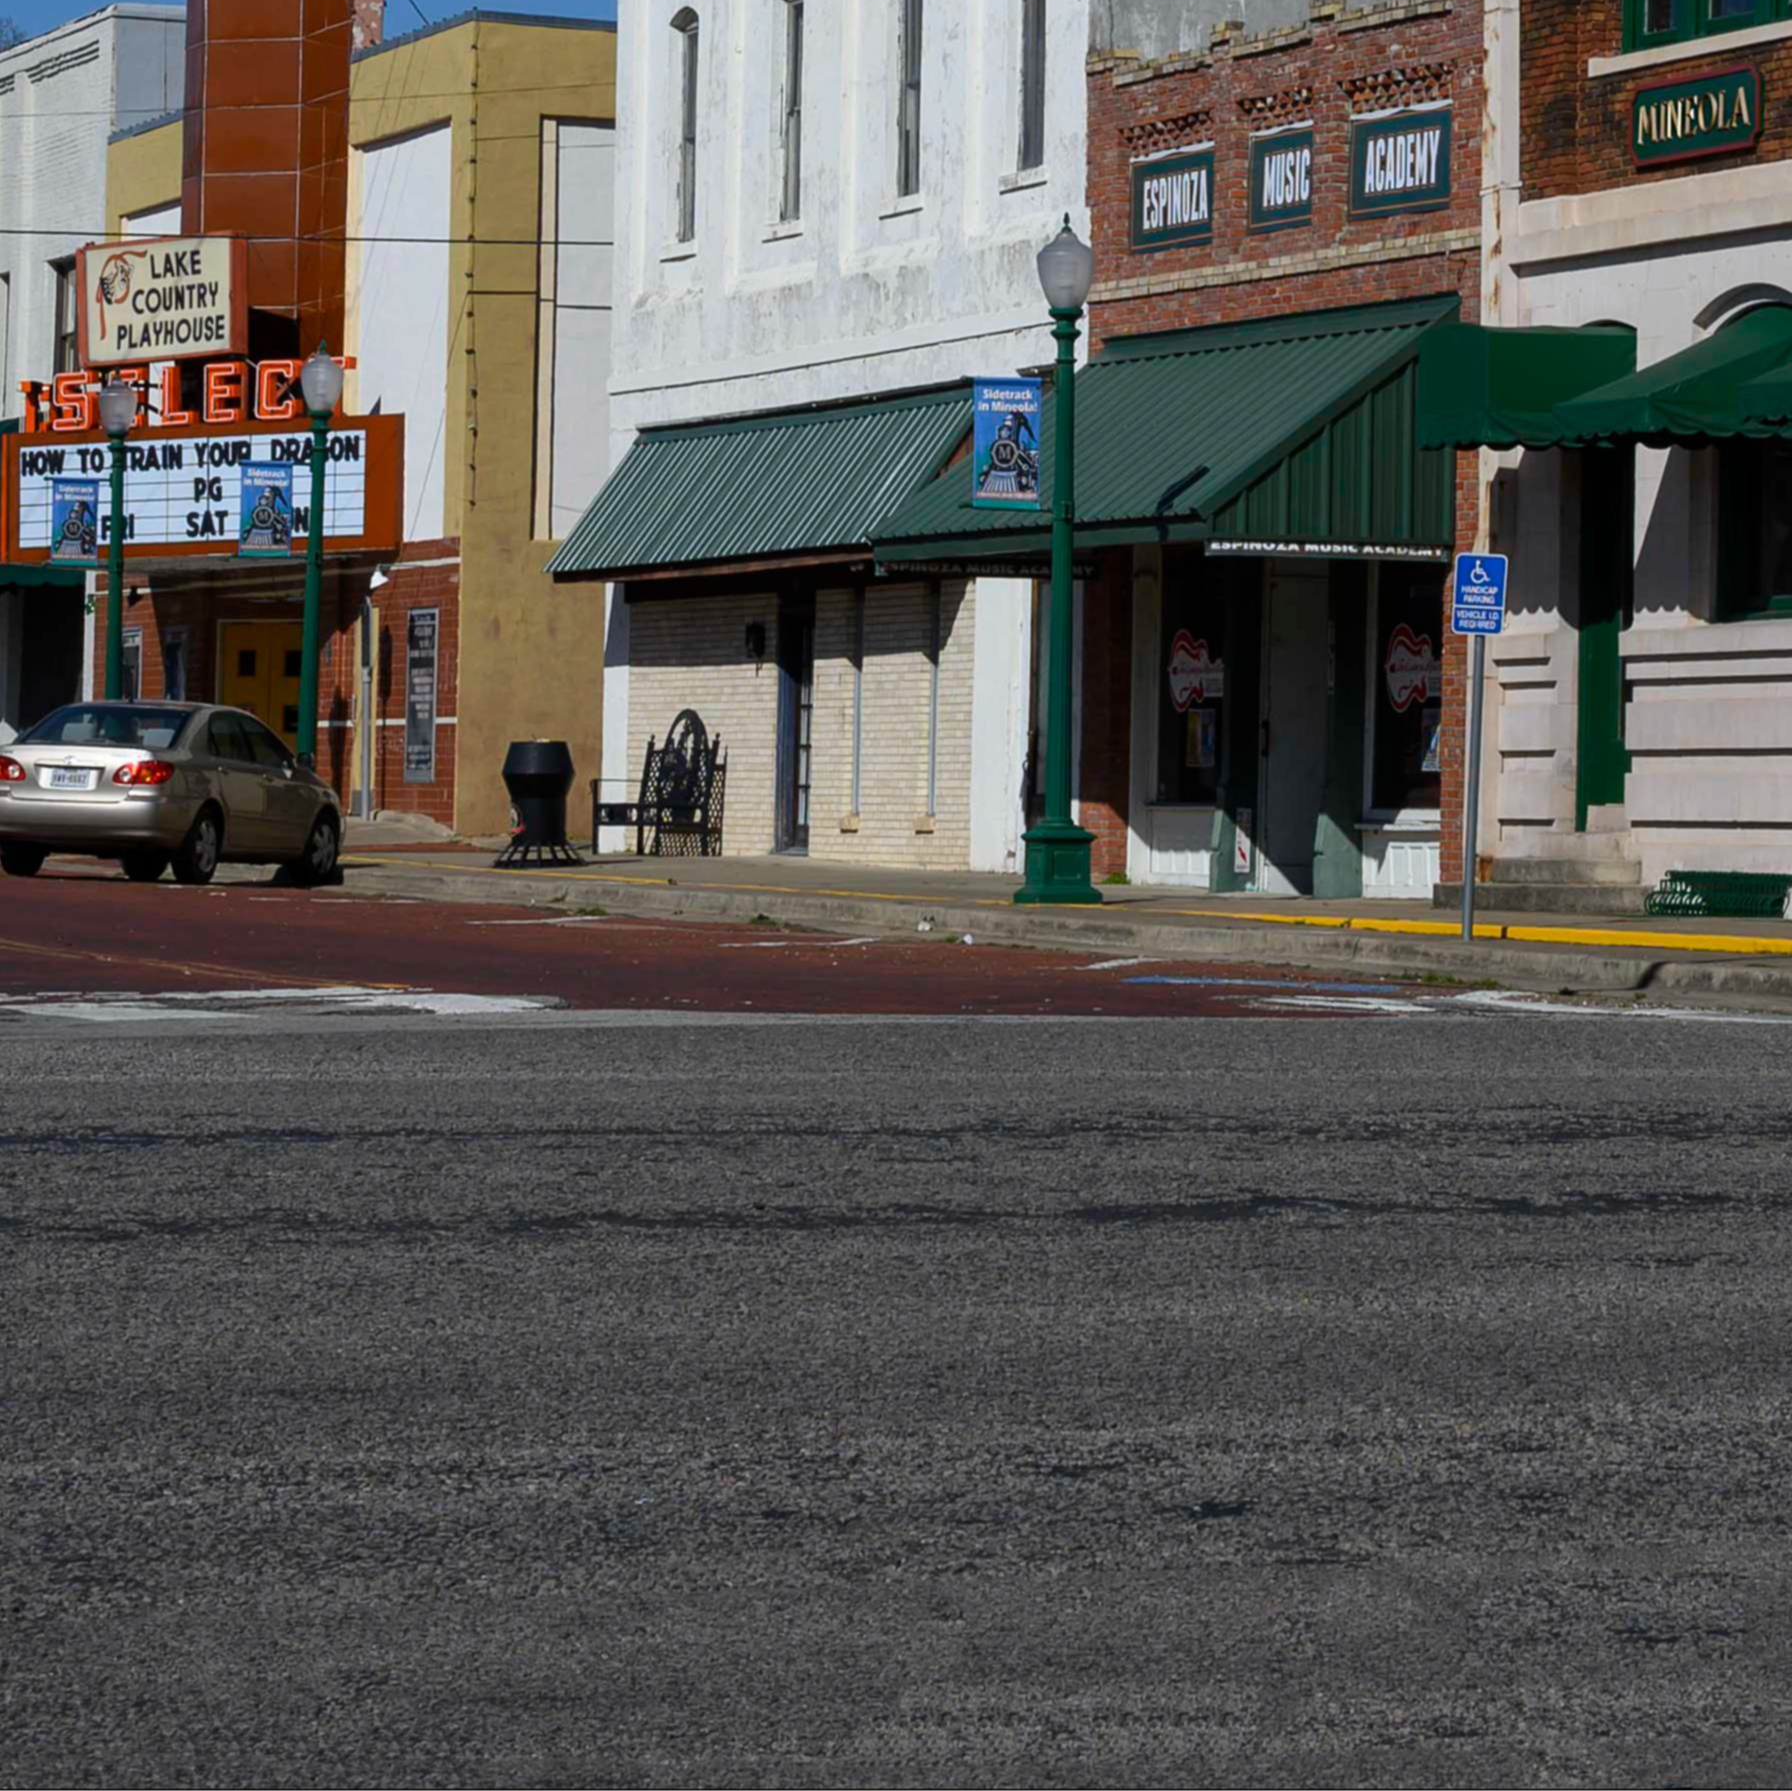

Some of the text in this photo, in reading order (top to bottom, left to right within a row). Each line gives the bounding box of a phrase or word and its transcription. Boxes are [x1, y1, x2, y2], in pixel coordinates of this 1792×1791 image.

[1637, 86, 1752, 146] MINEOLA
[1364, 129, 1441, 194] ACADEMY
[1263, 148, 1311, 208] MUSIC
[1143, 169, 1209, 230] ESPINOZA
[150, 250, 202, 279] LAKE
[132, 281, 218, 314] COUNTRY
[117, 315, 225, 350] PLAYHOUSE
[978, 401, 989, 412] in
[983, 388, 1034, 400] Sidetrack
[21, 449, 65, 476] HOW
[78, 448, 104, 473] TO
[271, 435, 360, 464] DRAON
[194, 477, 222, 503] PG
[186, 510, 228, 537] SAT
[1461, 585, 1499, 595] HANDICAP
[1463, 594, 1496, 604] PARKING
